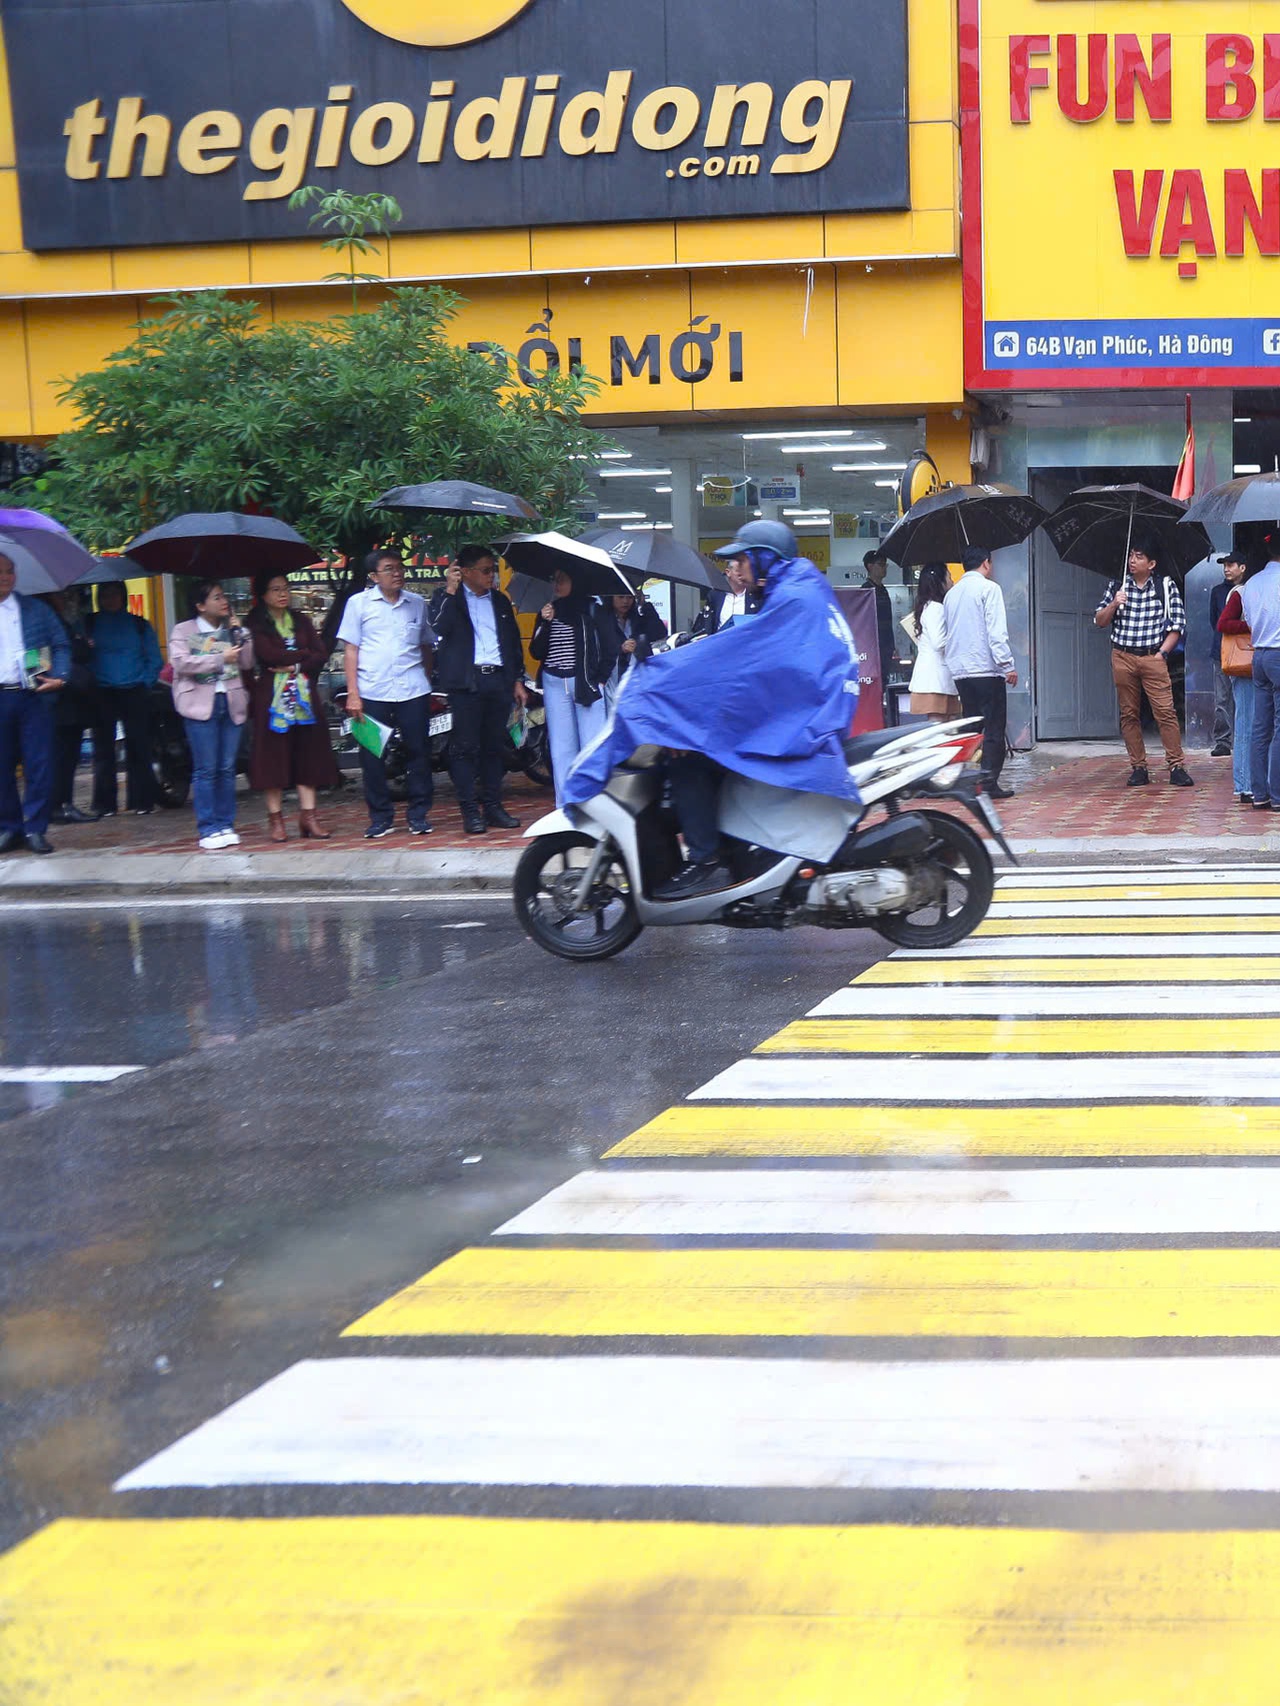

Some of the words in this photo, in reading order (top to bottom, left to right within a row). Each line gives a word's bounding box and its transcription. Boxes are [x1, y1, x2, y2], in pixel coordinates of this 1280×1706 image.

[1008, 33, 1173, 124] FUN
[63, 69, 853, 202] thegioididong
[665, 153, 761, 178] .com
[610, 315, 744, 387] MỚI
[1026, 336, 1061, 356] 64B
[1063, 336, 1097, 359] Vạn
[1102, 332, 1152, 357] Phúc,
[1158, 334, 1182, 355] Hà
[1187, 333, 1233, 357] Đông
